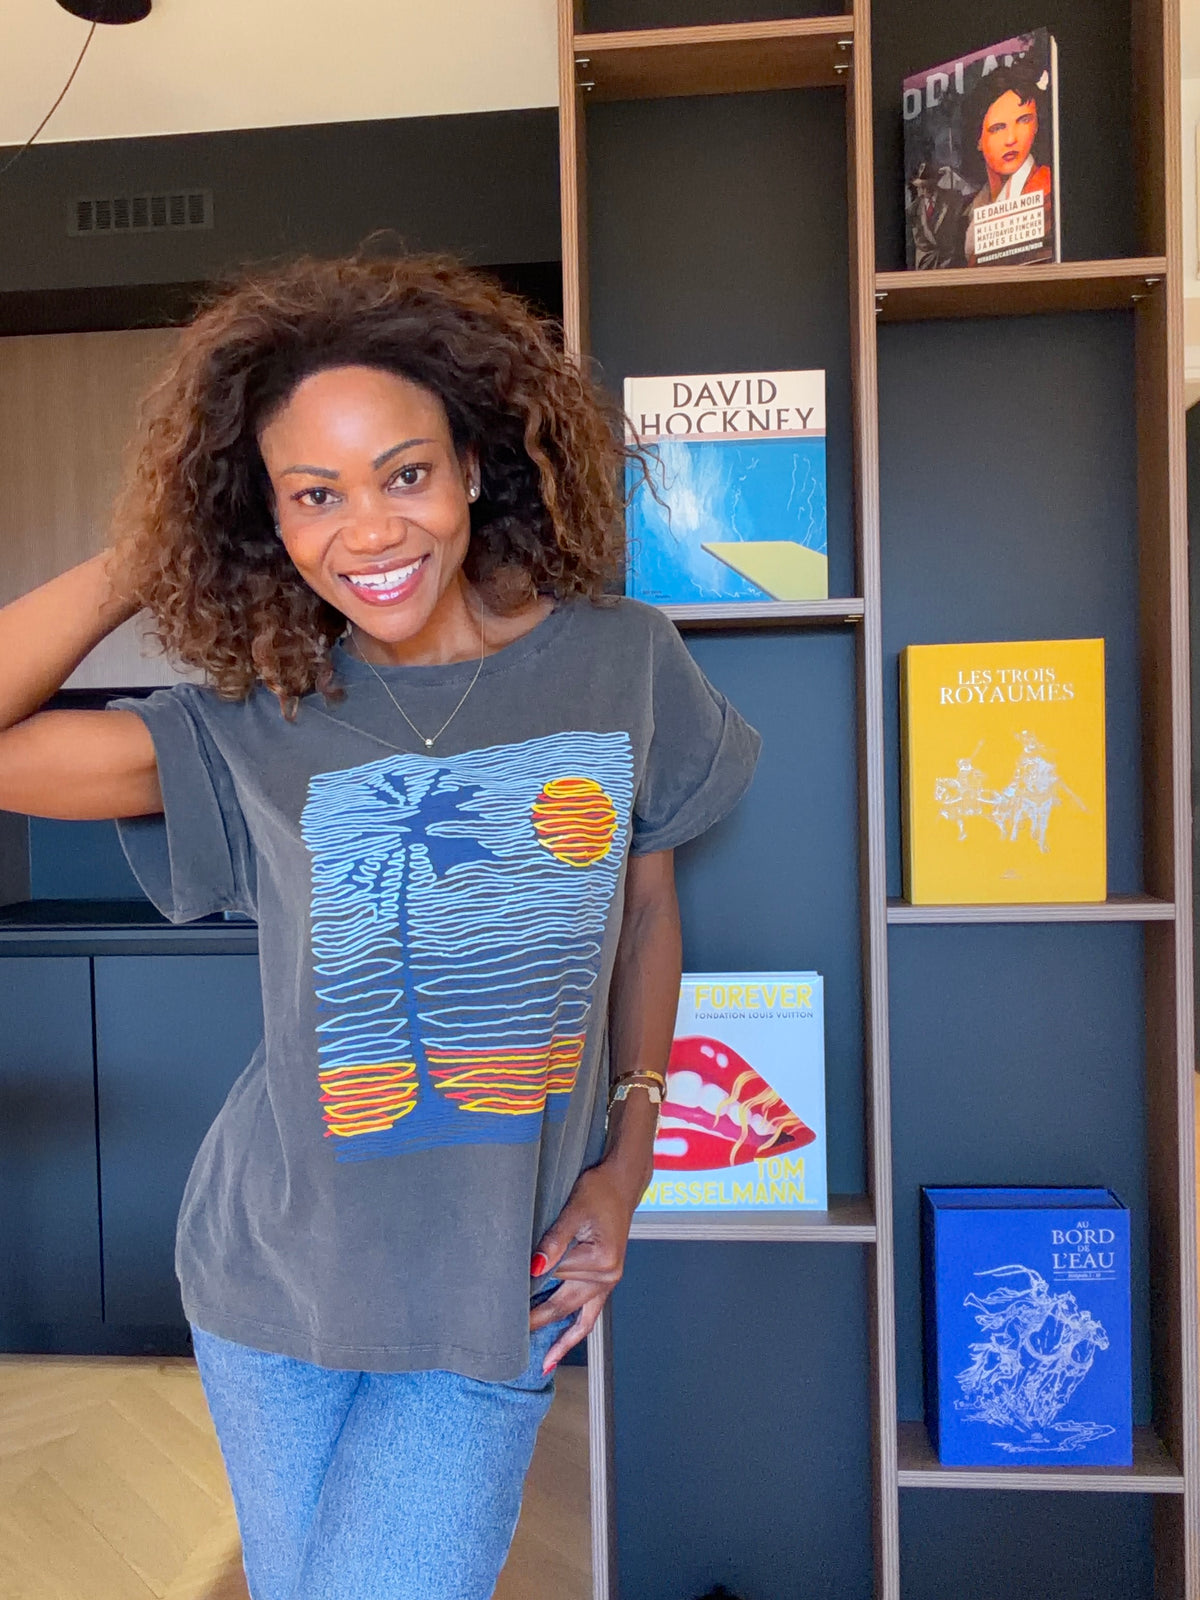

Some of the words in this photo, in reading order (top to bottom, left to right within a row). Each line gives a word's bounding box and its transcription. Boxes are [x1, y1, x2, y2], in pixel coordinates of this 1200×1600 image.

[977, 209, 986, 220] LE
[988, 201, 1018, 217] DAHLIA
[1020, 194, 1041, 207] NOIR
[977, 221, 1005, 234] MILES
[1009, 211, 1042, 224] HYMAN
[977, 237, 1006, 250] JAMES
[1009, 227, 1042, 243] ELLROY
[673, 379, 778, 408] DAVID
[640, 407, 815, 436] HOCKNEY
[958, 670, 992, 685] LES
[996, 667, 1056, 684] TROIS
[940, 683, 1075, 705] ROYAUMES
[695, 984, 812, 1009] FOREVER
[695, 1012, 746, 1020] FONDATION
[749, 1011, 774, 1019] LOUIS
[776, 1011, 814, 1019] VUITTON
[754, 1157, 804, 1181] TOM
[1051, 1228, 1115, 1245] BORD
[1076, 1221, 1089, 1229] AU
[1051, 1252, 1115, 1269] L'EAU
